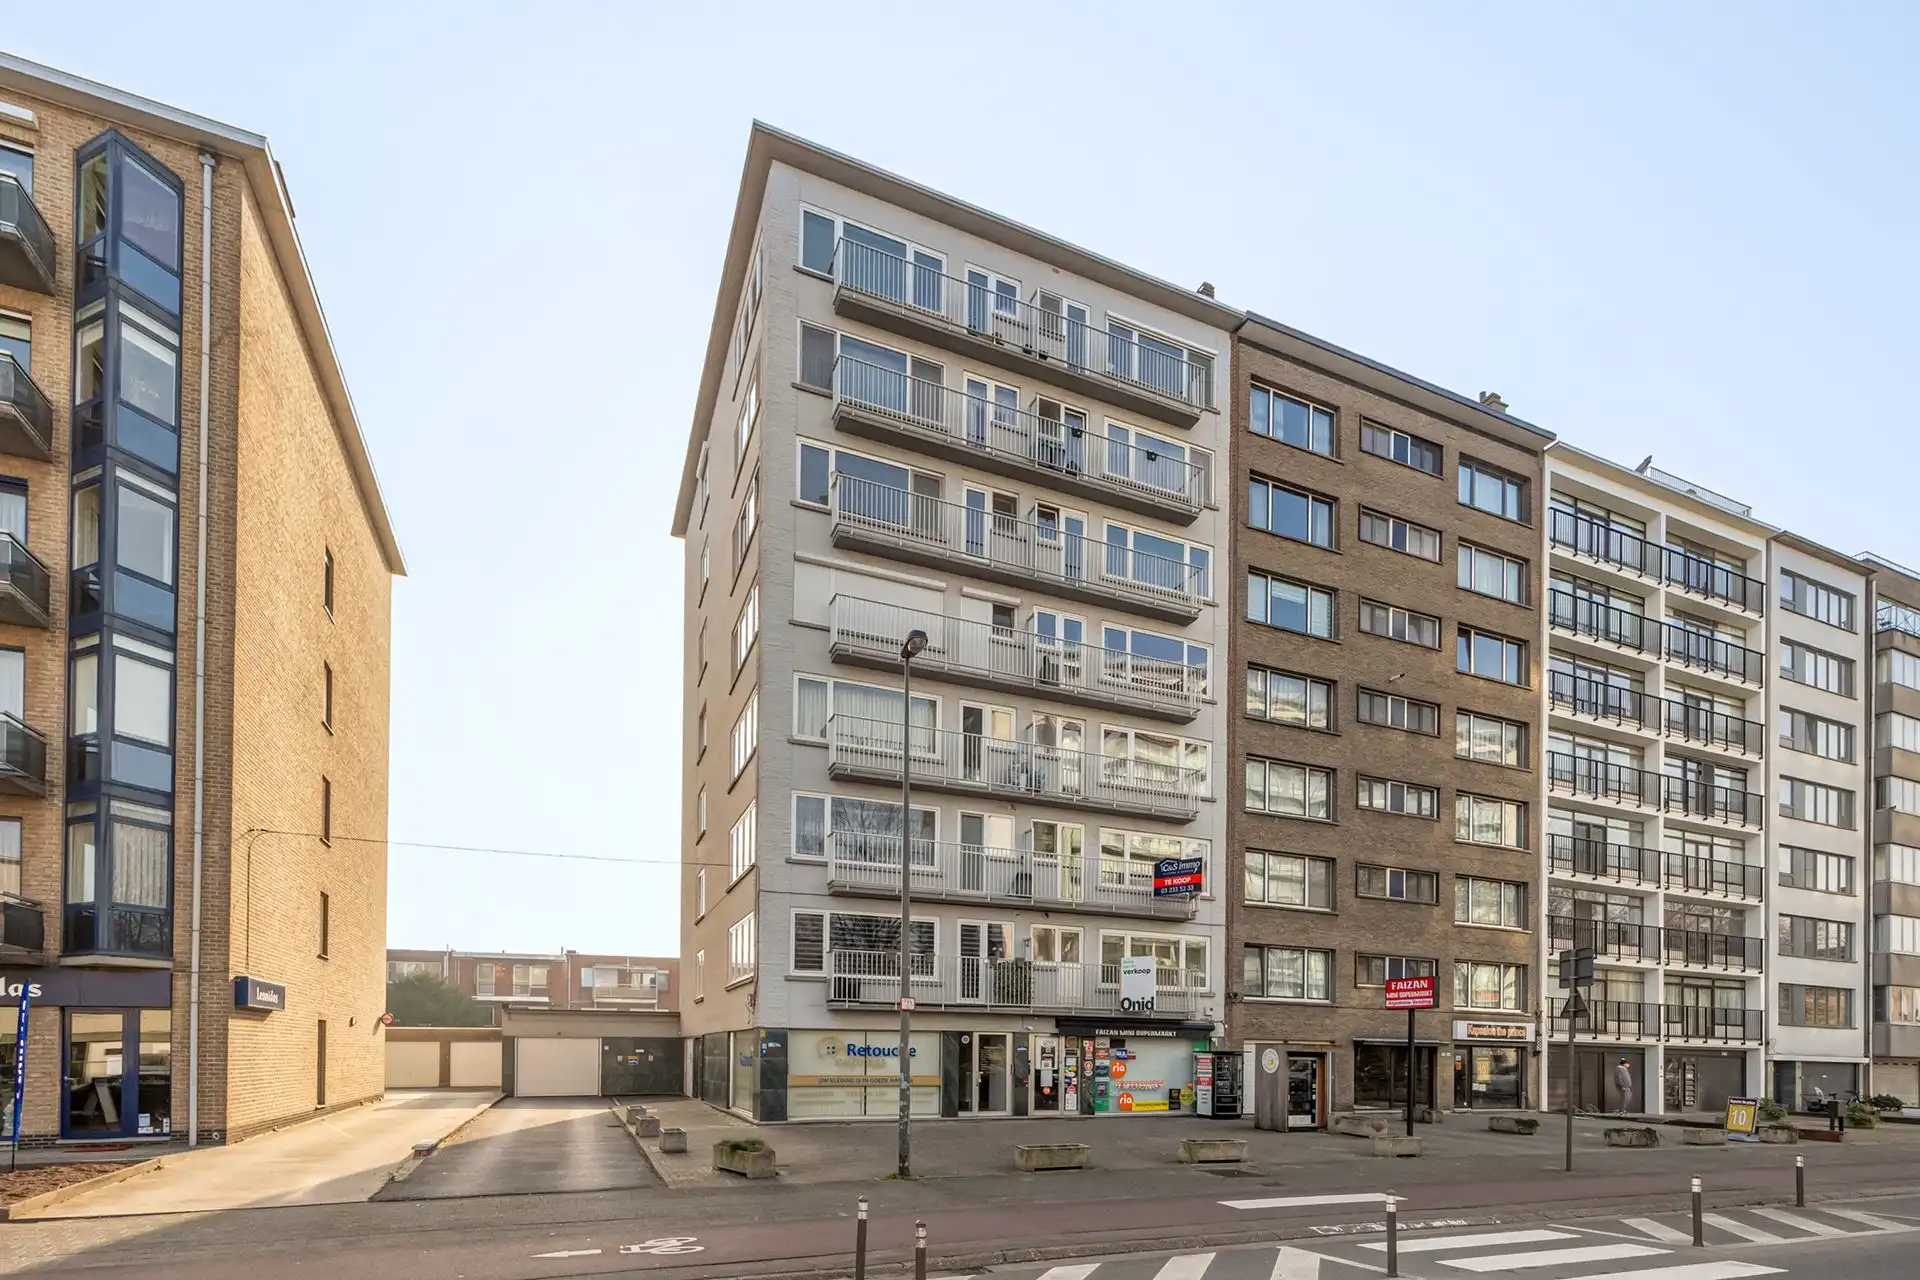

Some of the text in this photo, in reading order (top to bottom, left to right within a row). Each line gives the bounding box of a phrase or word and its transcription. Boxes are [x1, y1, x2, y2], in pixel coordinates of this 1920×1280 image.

[1173, 877, 1191, 885] KOOP
[1391, 980, 1428, 990] FAIZAN
[256, 986, 279, 1004] Leonidas
[1121, 997, 1154, 1011] Onid
[846, 1043, 917, 1057] Retouce
[1112, 1062, 1125, 1072] ria
[1119, 1094, 1132, 1104] ria
